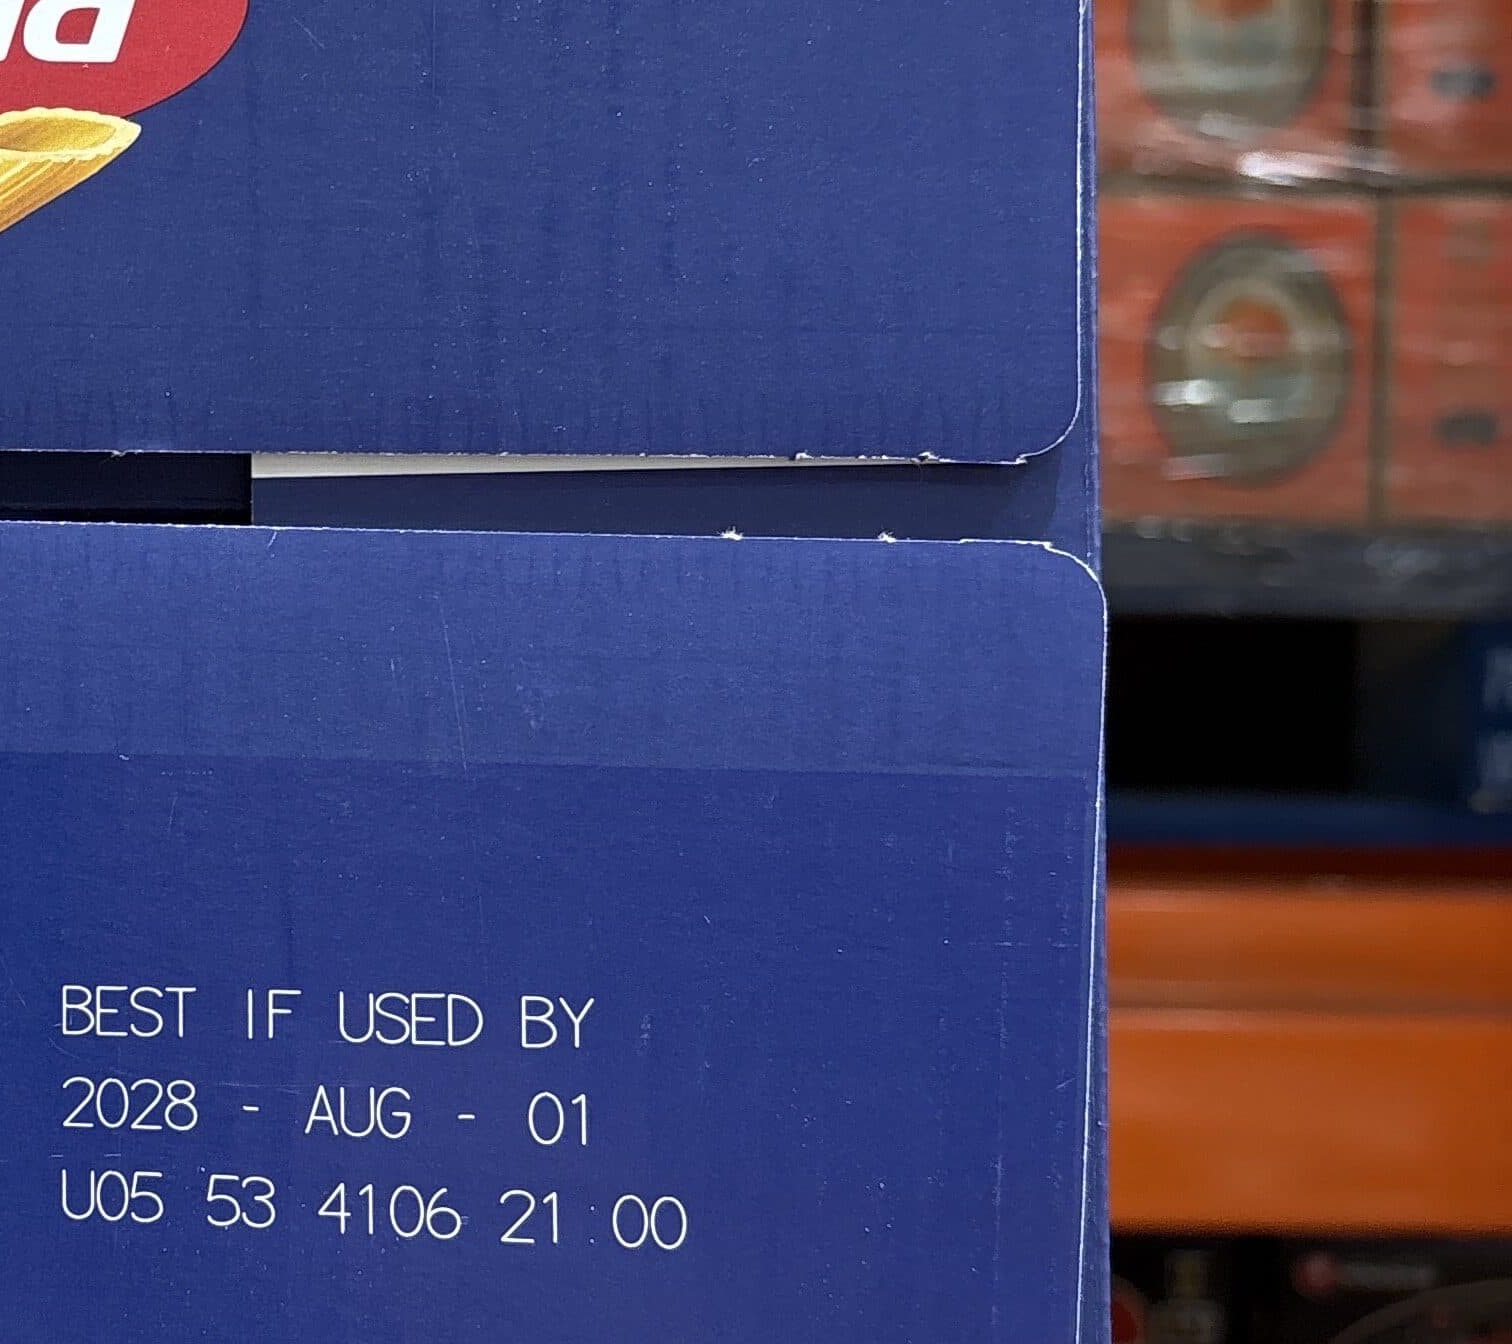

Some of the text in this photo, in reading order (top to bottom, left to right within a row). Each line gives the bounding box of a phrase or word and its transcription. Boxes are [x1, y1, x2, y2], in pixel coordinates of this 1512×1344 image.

[62, 984, 595, 1049] BEST IF USED BY
[62, 1076, 198, 1131] 2028
[304, 1084, 412, 1139] AUG
[528, 1091, 588, 1146] 01
[61, 1168, 164, 1223] U05
[206, 1174, 276, 1229] 53
[317, 1182, 463, 1240] 4106
[499, 1189, 559, 1244] 21
[612, 1194, 688, 1250] 00
